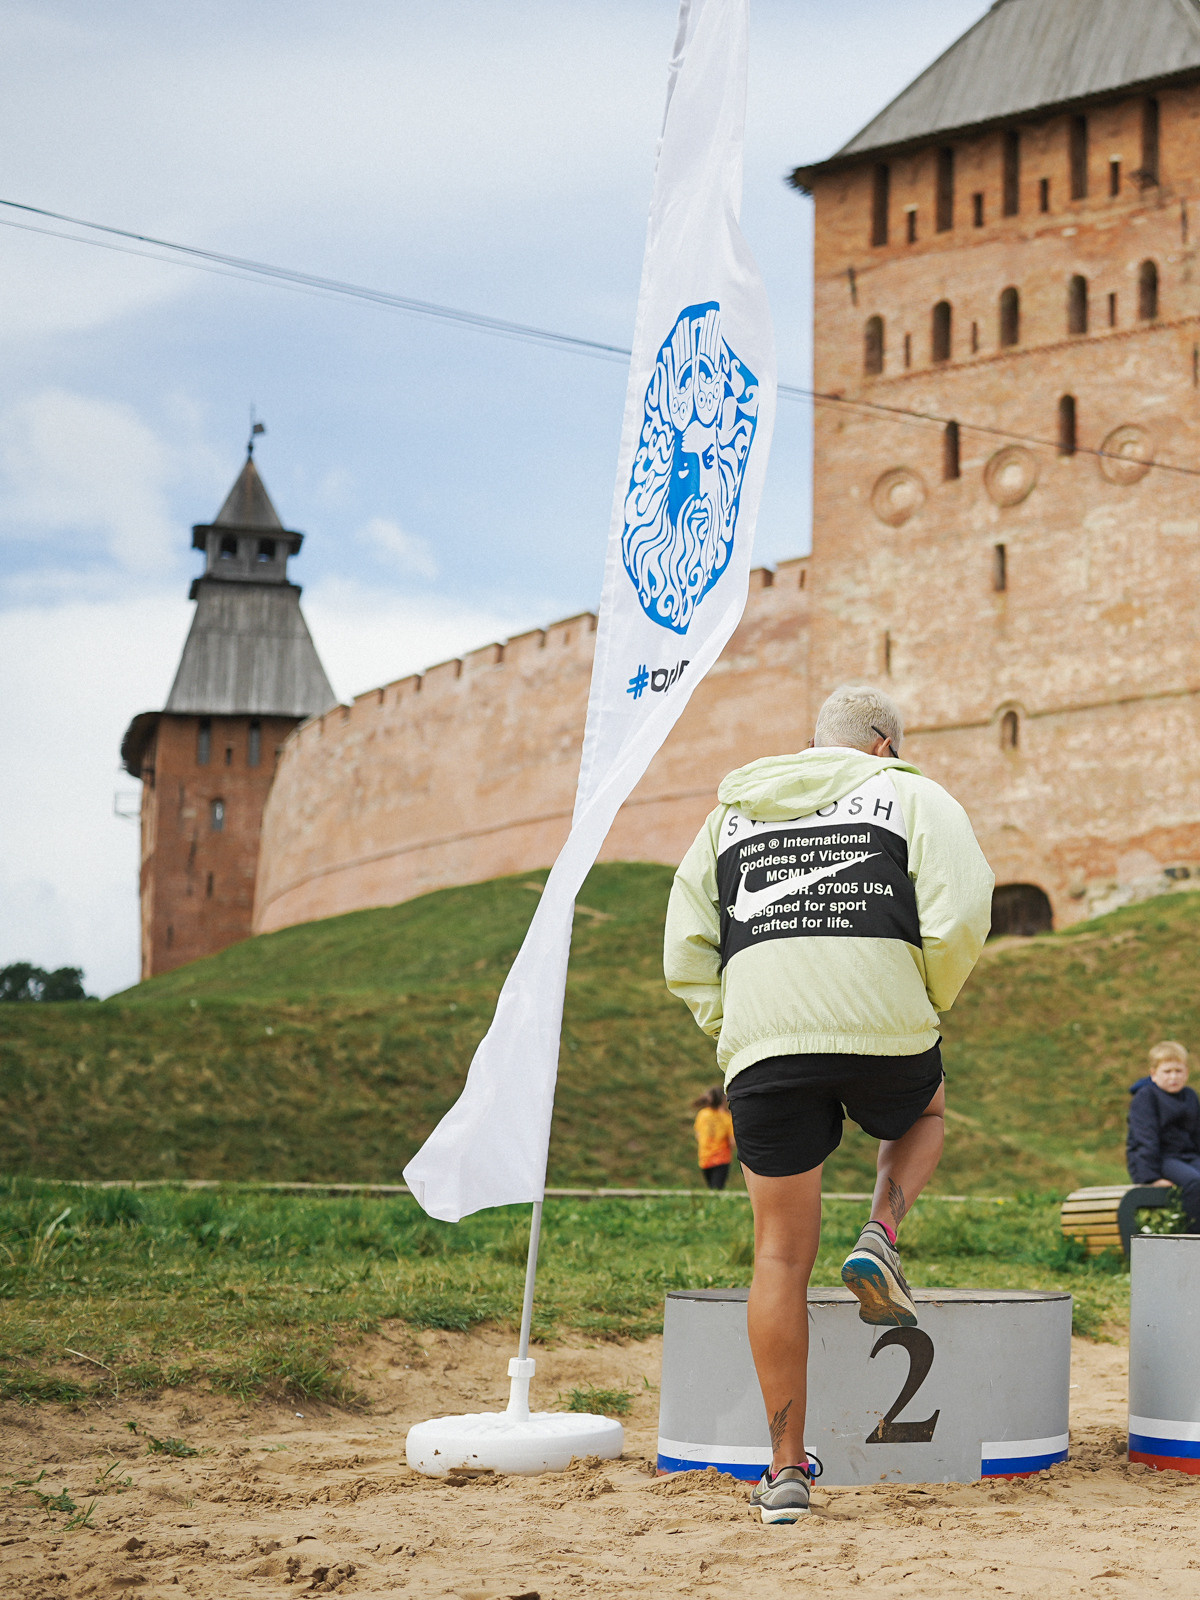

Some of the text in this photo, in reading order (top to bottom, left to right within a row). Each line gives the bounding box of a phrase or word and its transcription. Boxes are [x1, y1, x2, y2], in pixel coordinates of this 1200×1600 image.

[739, 842, 766, 859] Nike
[783, 832, 871, 848] International
[740, 850, 869, 874] Goddess of Victory
[817, 882, 859, 896] 97005
[863, 882, 894, 897] USA
[804, 901, 825, 912] for
[829, 900, 867, 914] sport
[751, 916, 853, 936] crafted for life.
[865, 1325, 941, 1444] 2
